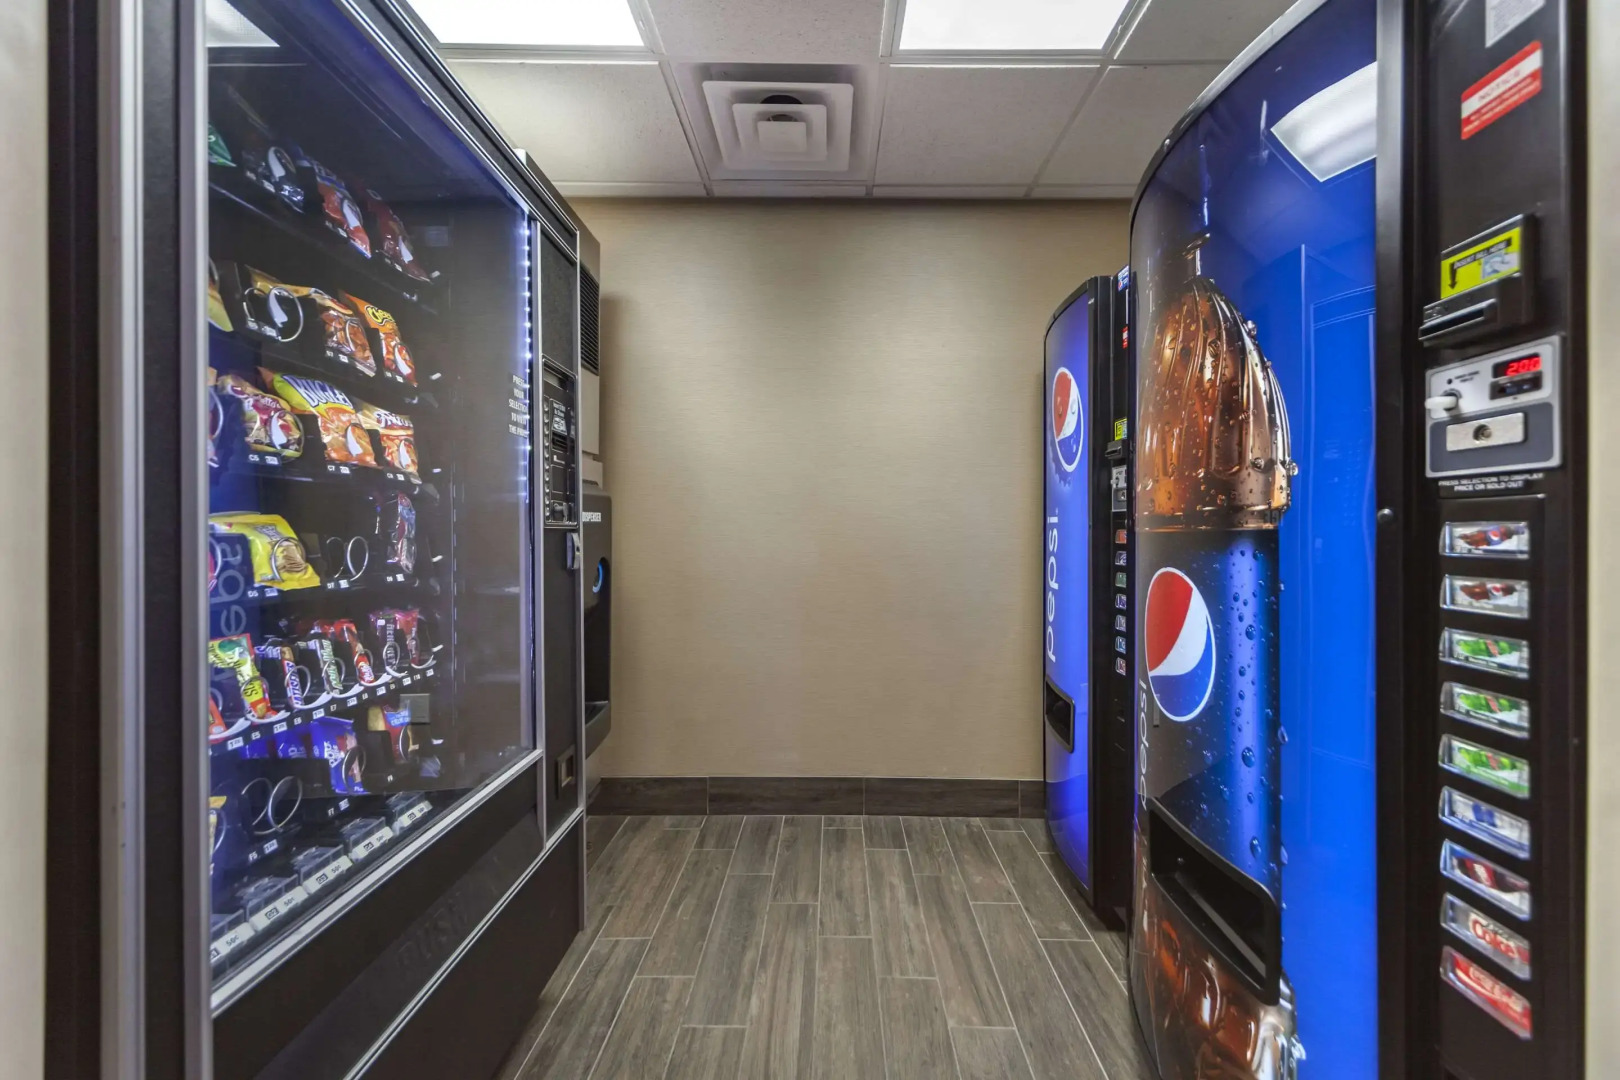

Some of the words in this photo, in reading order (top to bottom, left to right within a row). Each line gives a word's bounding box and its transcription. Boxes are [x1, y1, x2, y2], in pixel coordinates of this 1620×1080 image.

[1438, 479, 1460, 487] PRESS
[1460, 475, 1499, 485] SELECTION
[1510, 472, 1544, 481] DISPLAY
[1454, 483, 1473, 491] PRICE
[1474, 482, 1486, 490] OR
[1486, 481, 1506, 489] SOLD
[1507, 480, 1523, 488] OUT
[1046, 514, 1059, 663] pepsi
[1138, 679, 1149, 812] pepsi
